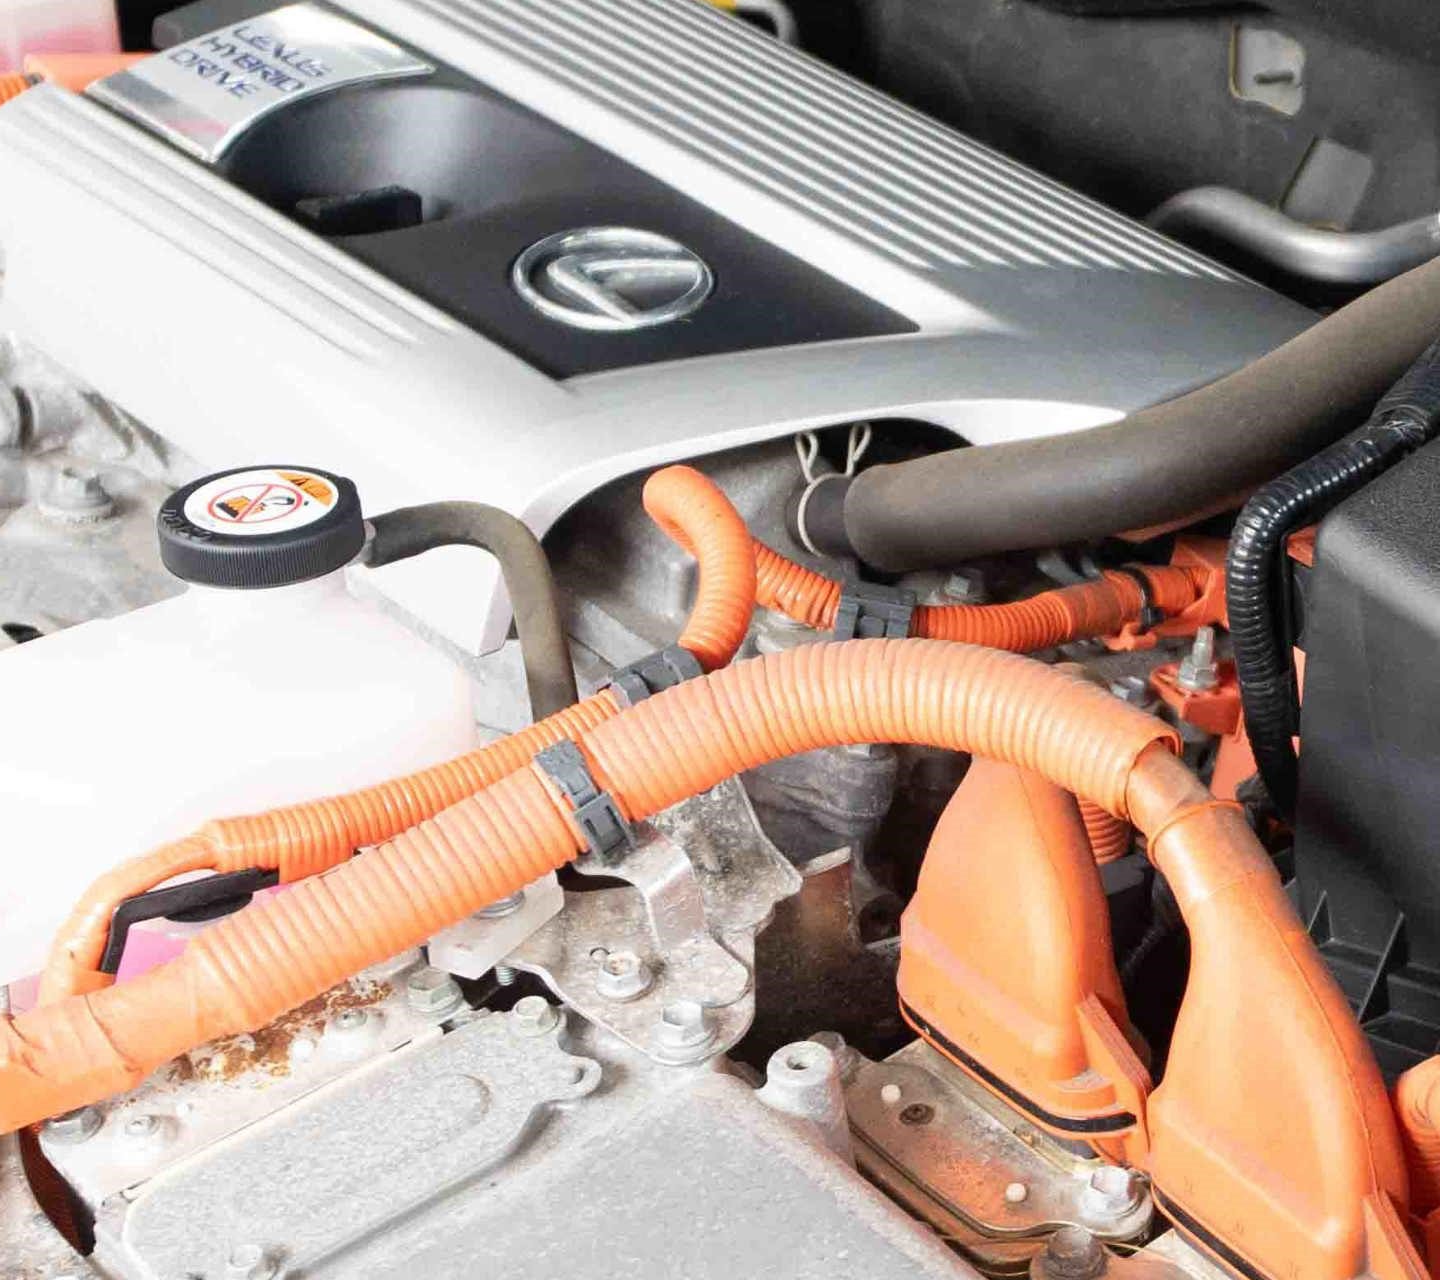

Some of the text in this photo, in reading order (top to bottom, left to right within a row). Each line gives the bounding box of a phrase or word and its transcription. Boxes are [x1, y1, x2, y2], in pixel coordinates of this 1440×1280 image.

[169, 49, 260, 98] DRIVE
[201, 36, 305, 92] HYBRID
[233, 25, 331, 77] LEXUS
